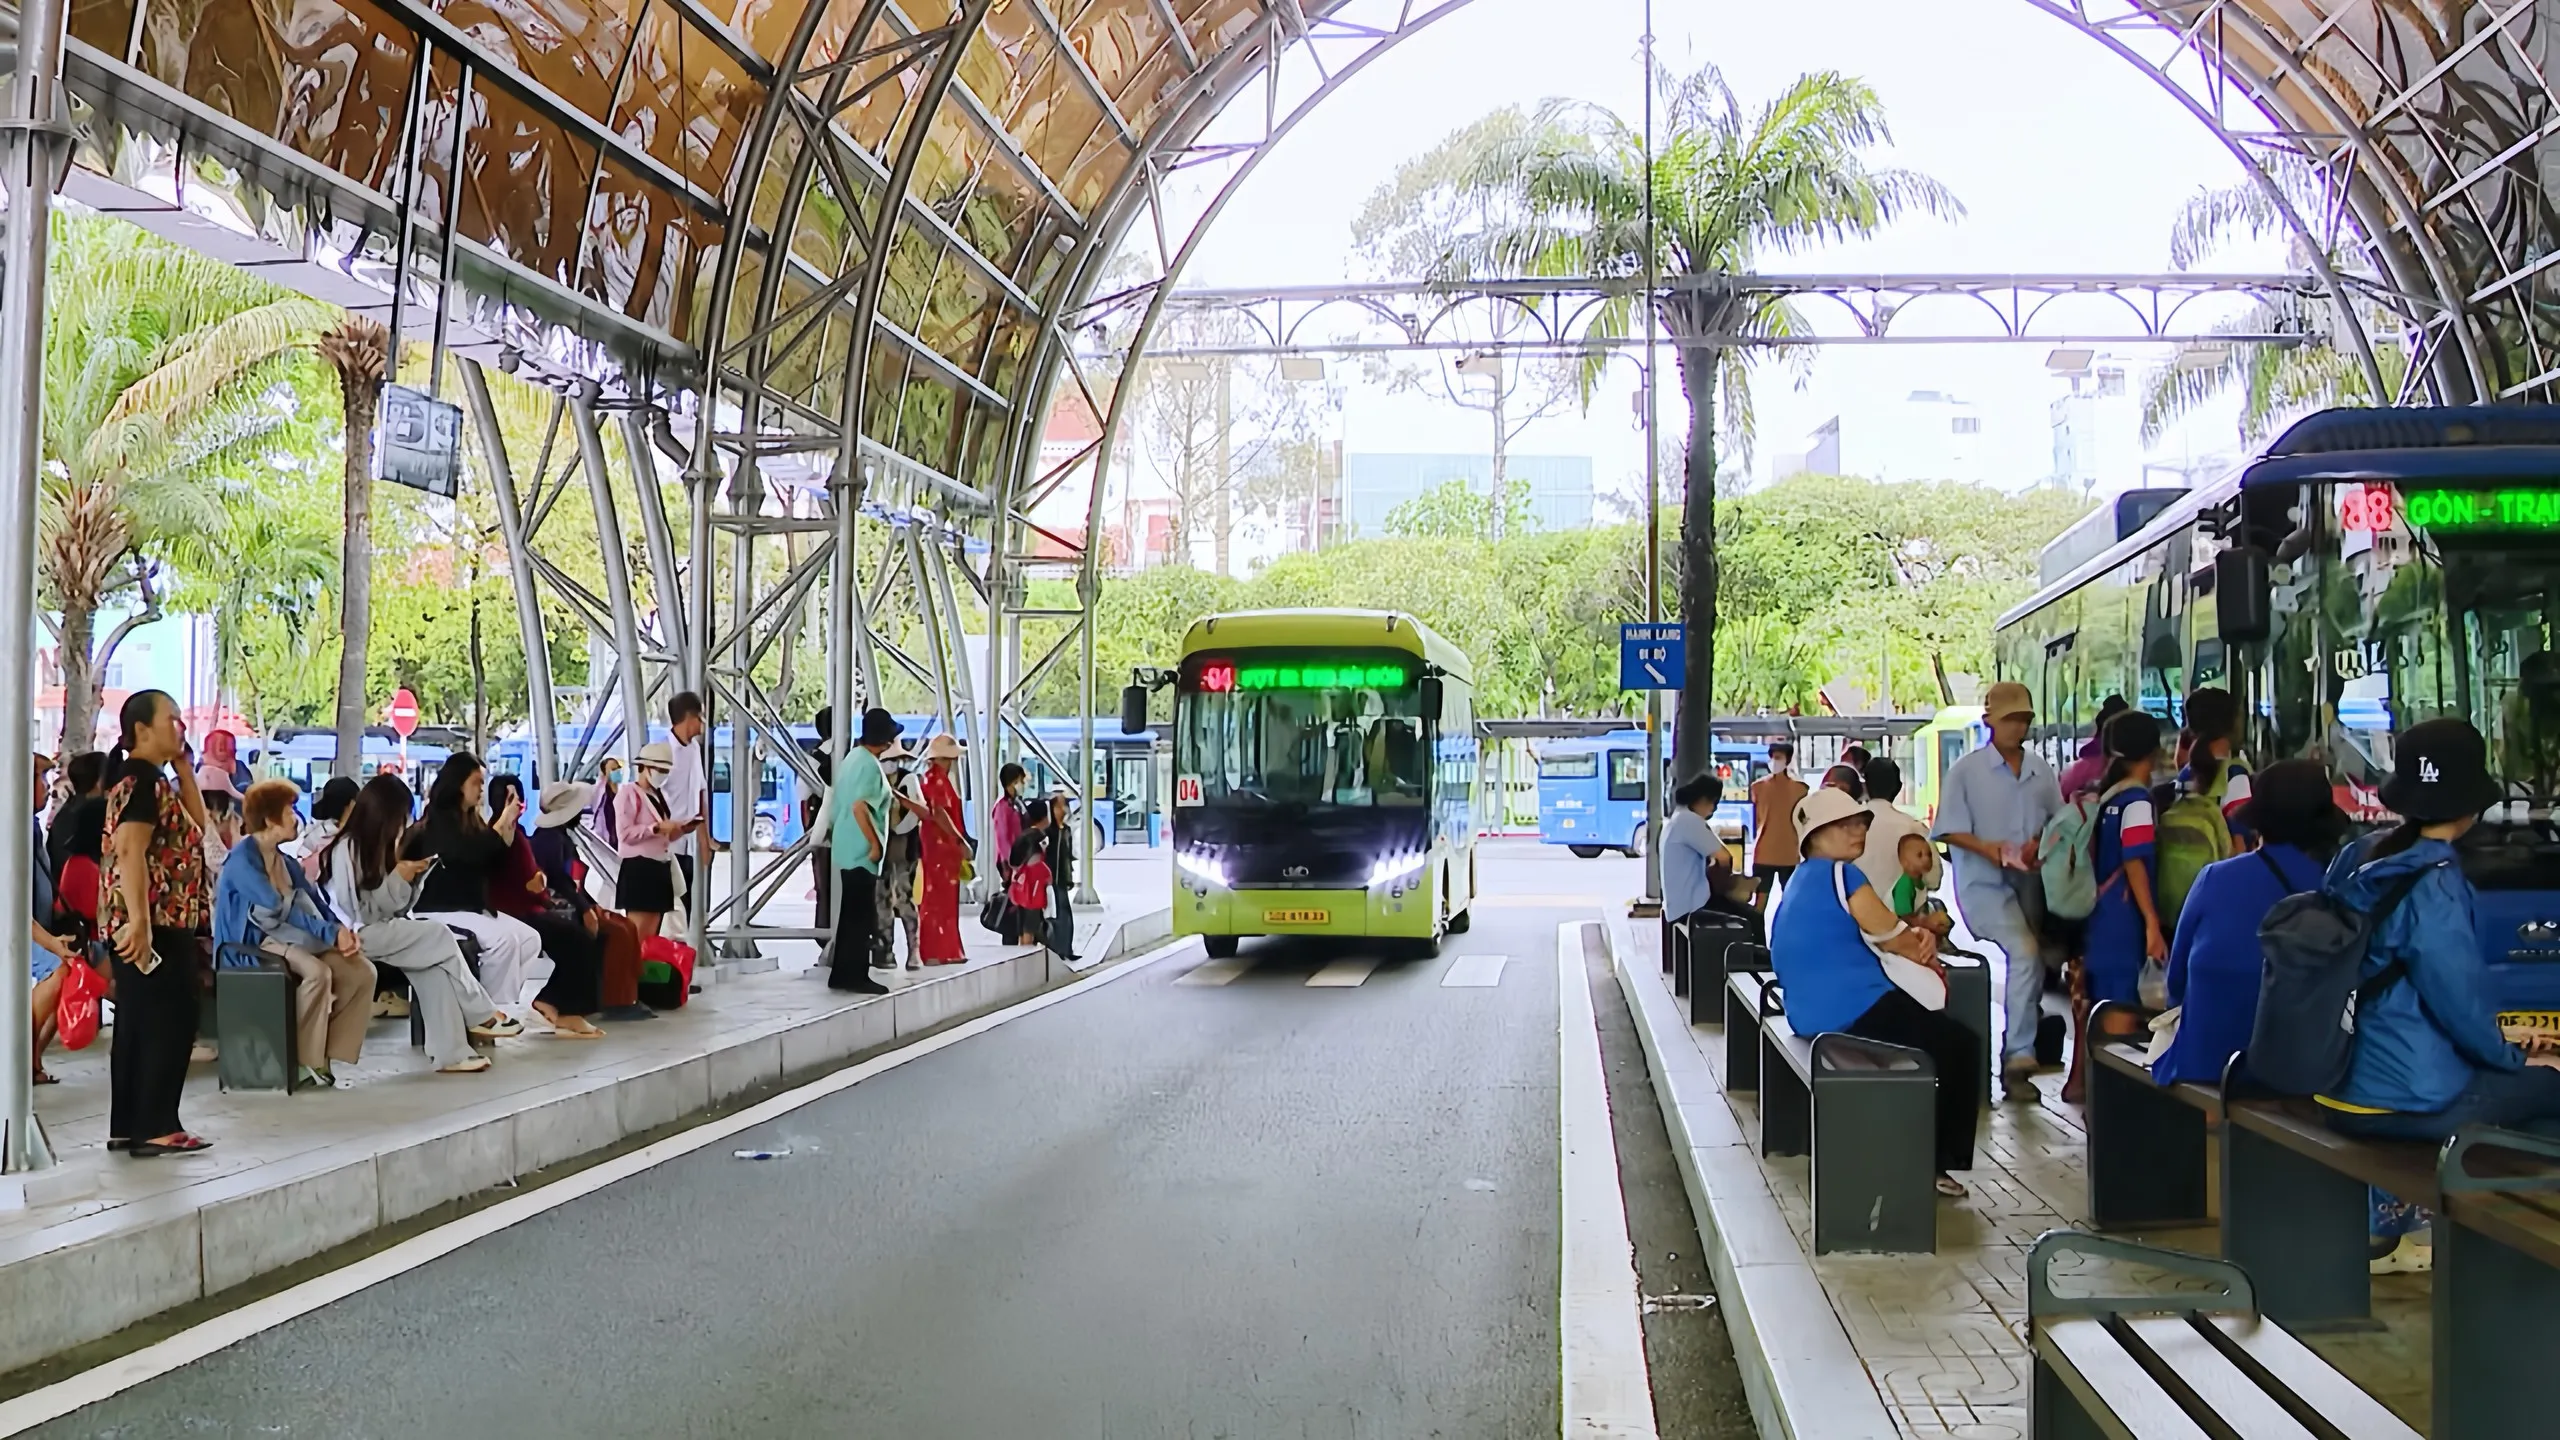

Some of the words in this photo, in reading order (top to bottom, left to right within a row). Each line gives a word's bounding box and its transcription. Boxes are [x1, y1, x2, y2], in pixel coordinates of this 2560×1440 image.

[2345, 490, 2391, 531] 88
[2409, 489, 2473, 526] GÒN
[2418, 756, 2439, 782] LA
[1179, 779, 1199, 801] 04
